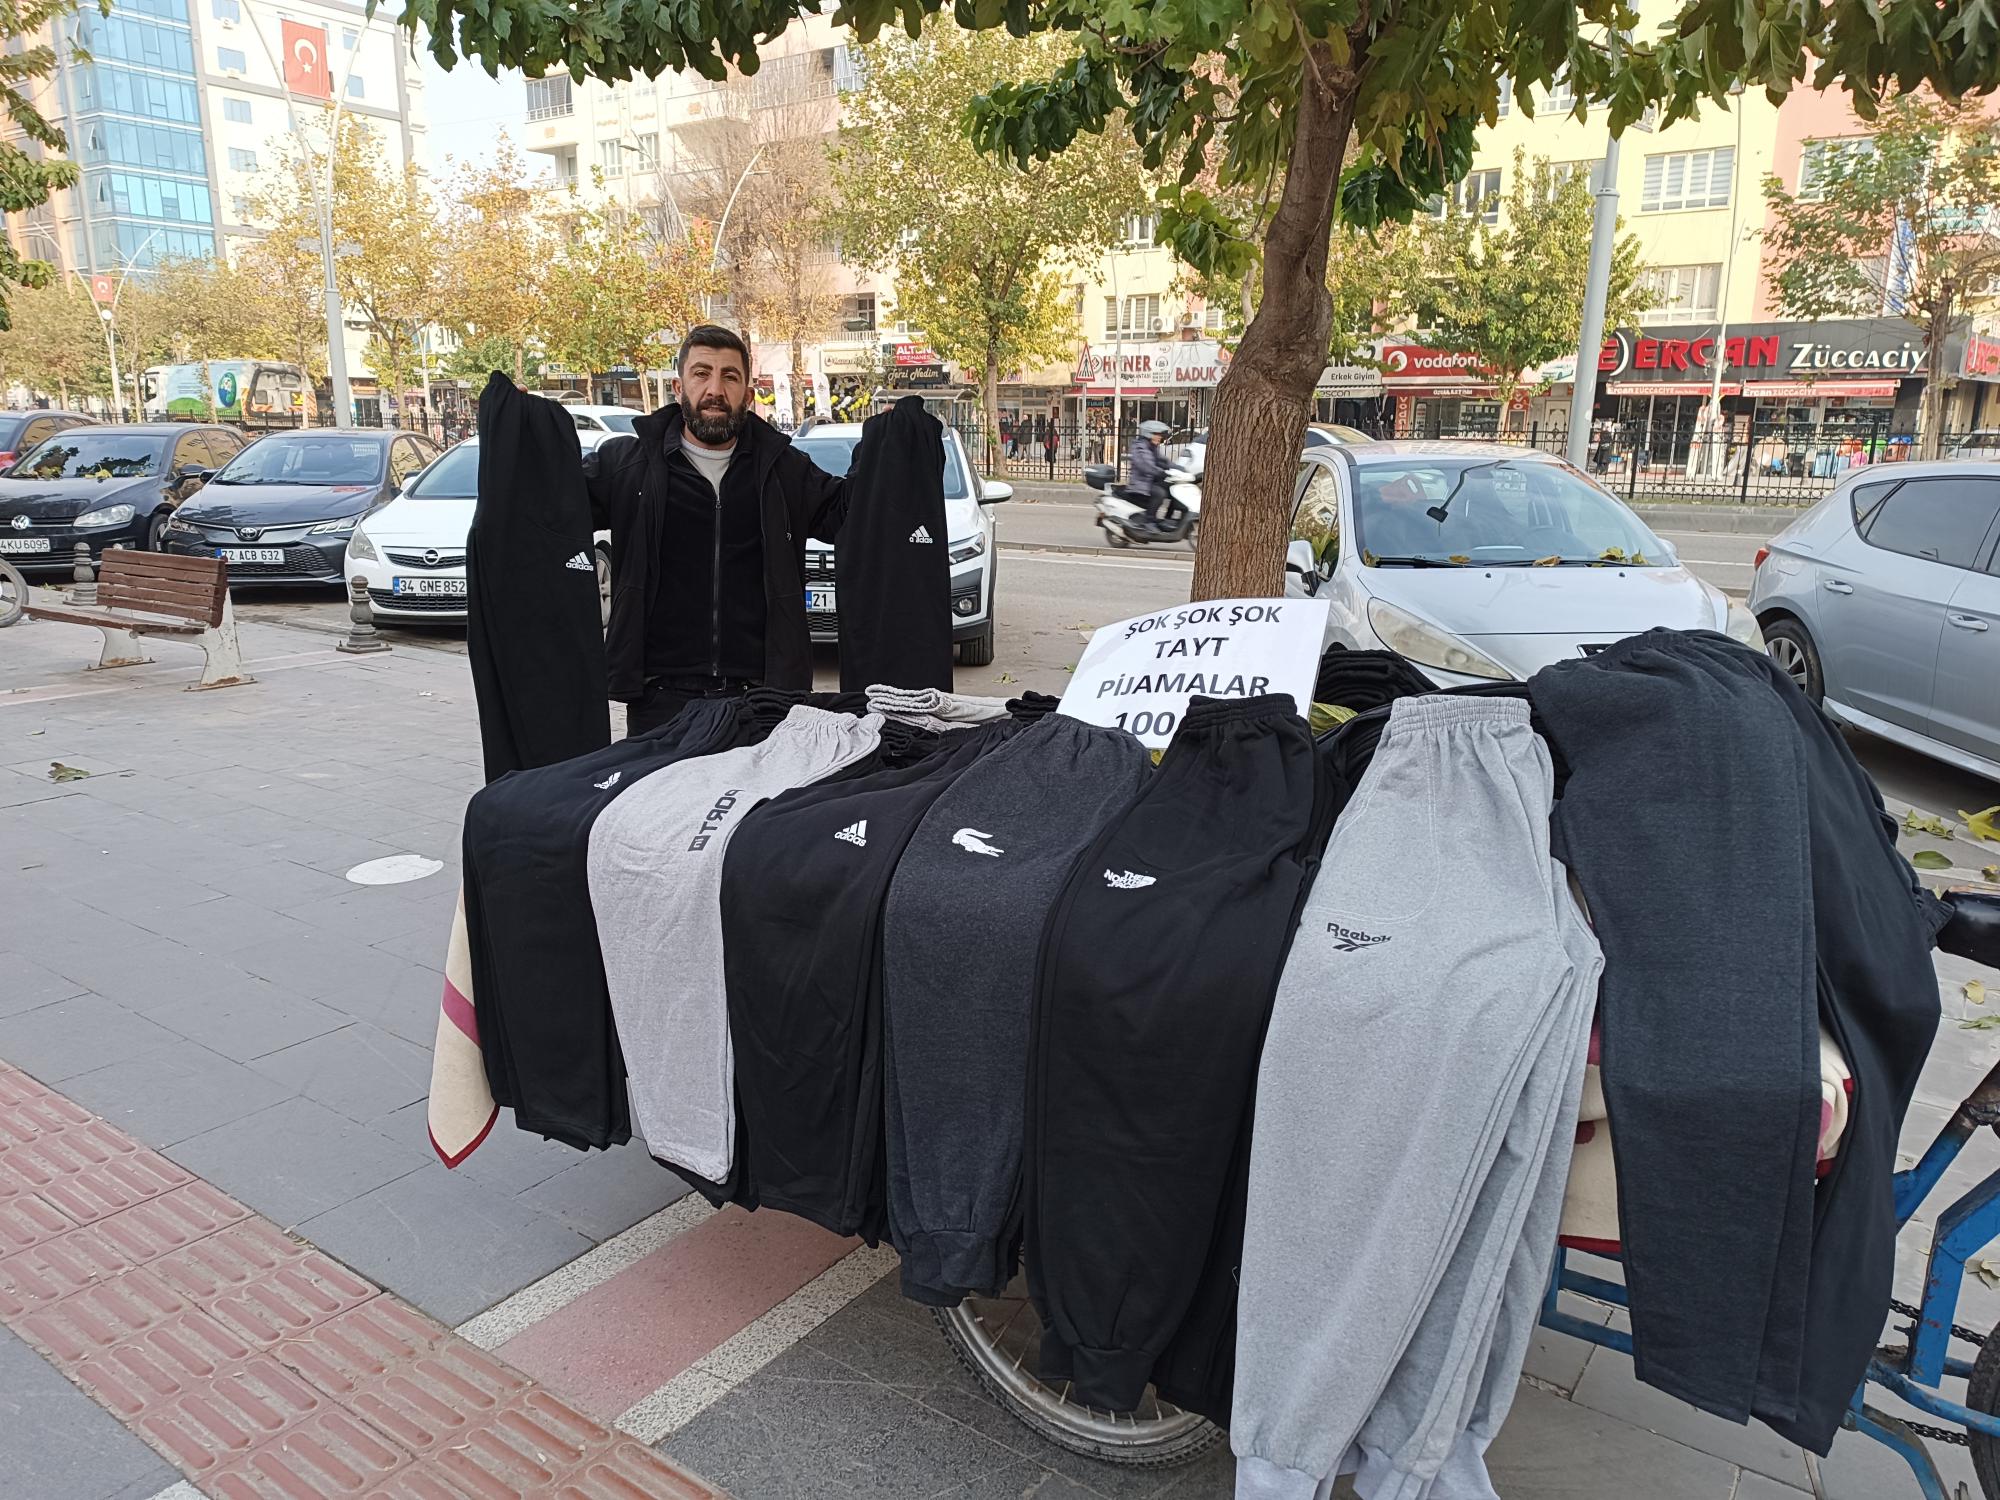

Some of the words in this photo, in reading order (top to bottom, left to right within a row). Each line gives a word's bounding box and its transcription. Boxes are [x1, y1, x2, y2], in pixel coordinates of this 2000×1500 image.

[1635, 335, 1780, 371] ERCAN
[1175, 367, 1218, 382] BADUK
[1331, 373, 1352, 381] Erkek
[1354, 373, 1375, 382] Giyim
[239, 550, 257, 561] ACB
[261, 550, 280, 561] 632
[400, 580, 414, 592] 34
[813, 593, 827, 607] 21
[1124, 613, 1171, 640] ŞOK
[1173, 606, 1224, 630] ŞOK
[1228, 605, 1283, 626] ŞOK
[1154, 637, 1230, 659] TAYT
[1096, 673, 1270, 699] PİJAMALAR
[1114, 711, 1176, 736] 100
[1326, 922, 1393, 943] Reebok
